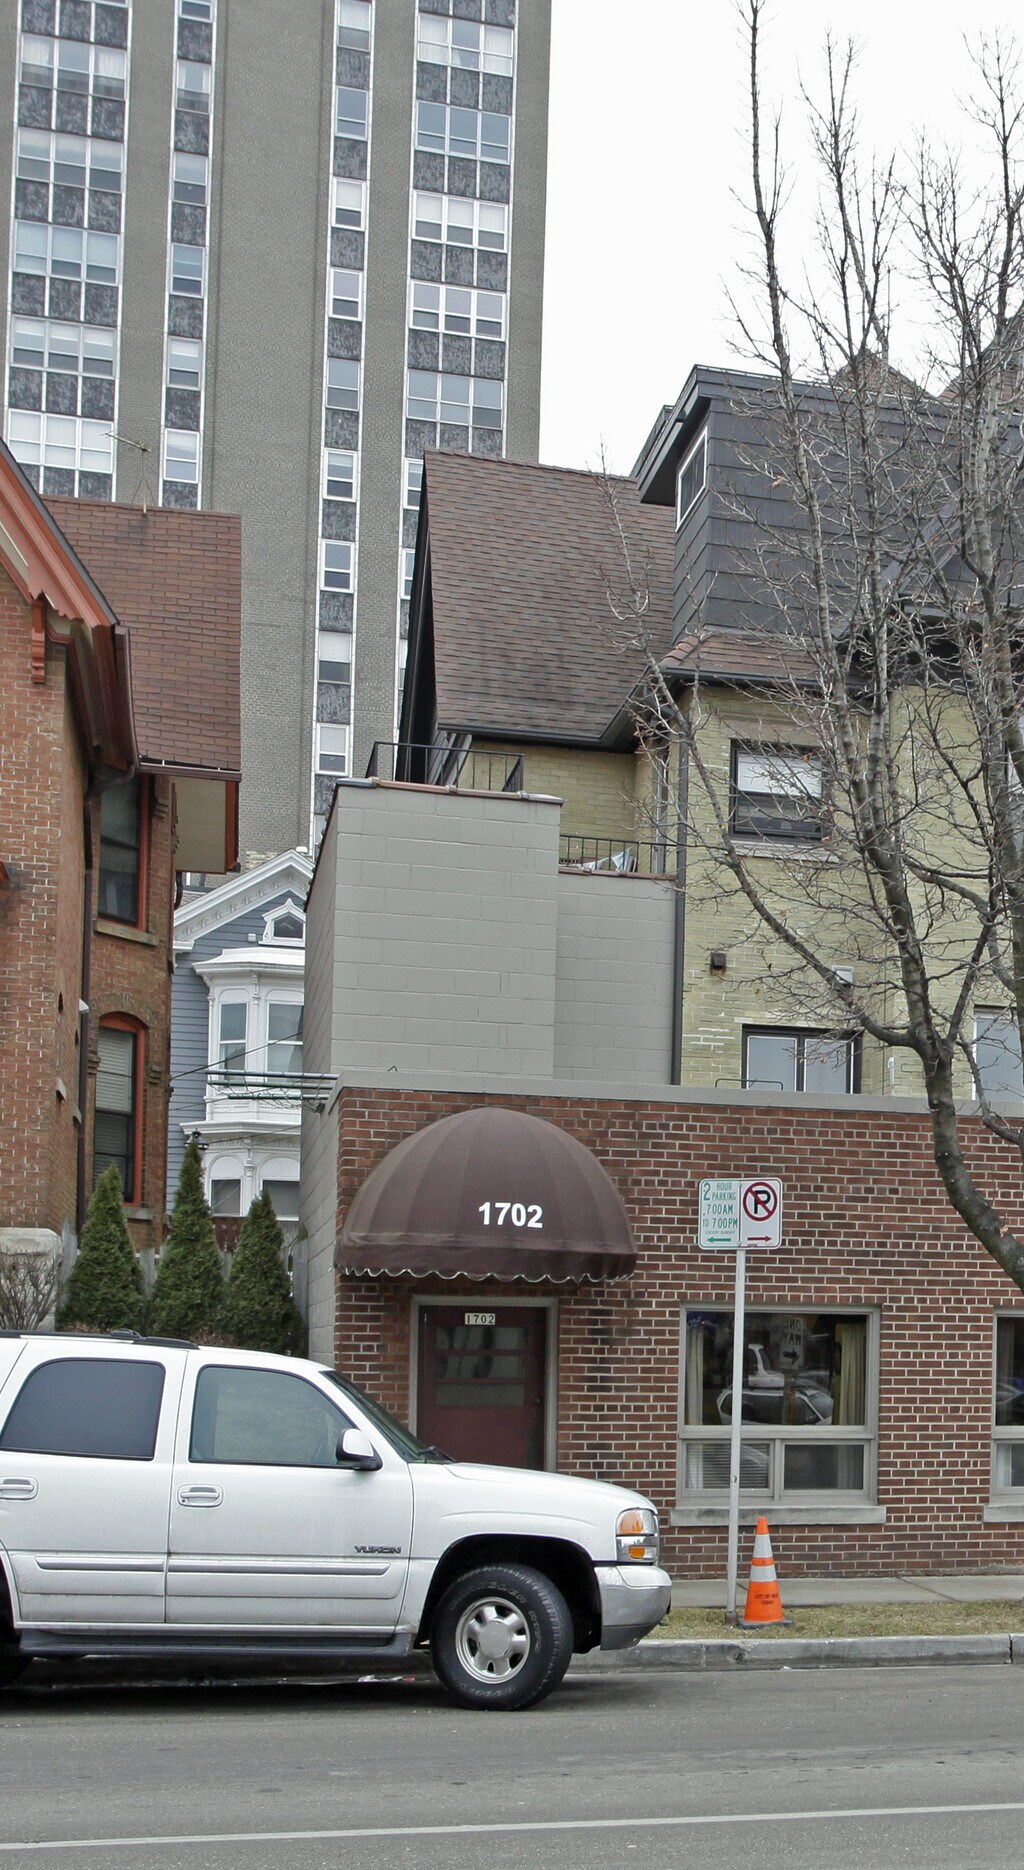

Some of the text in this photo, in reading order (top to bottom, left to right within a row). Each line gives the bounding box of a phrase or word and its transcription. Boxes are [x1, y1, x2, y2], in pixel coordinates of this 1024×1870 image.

[703, 1182, 732, 1201] 2 HOUR
[712, 1192, 737, 1201] PARKING
[478, 1201, 543, 1229] 1702
[702, 1218, 709, 1228] TO
[467, 1314, 494, 1324] 1702
[353, 1545, 402, 1554] YUKON
